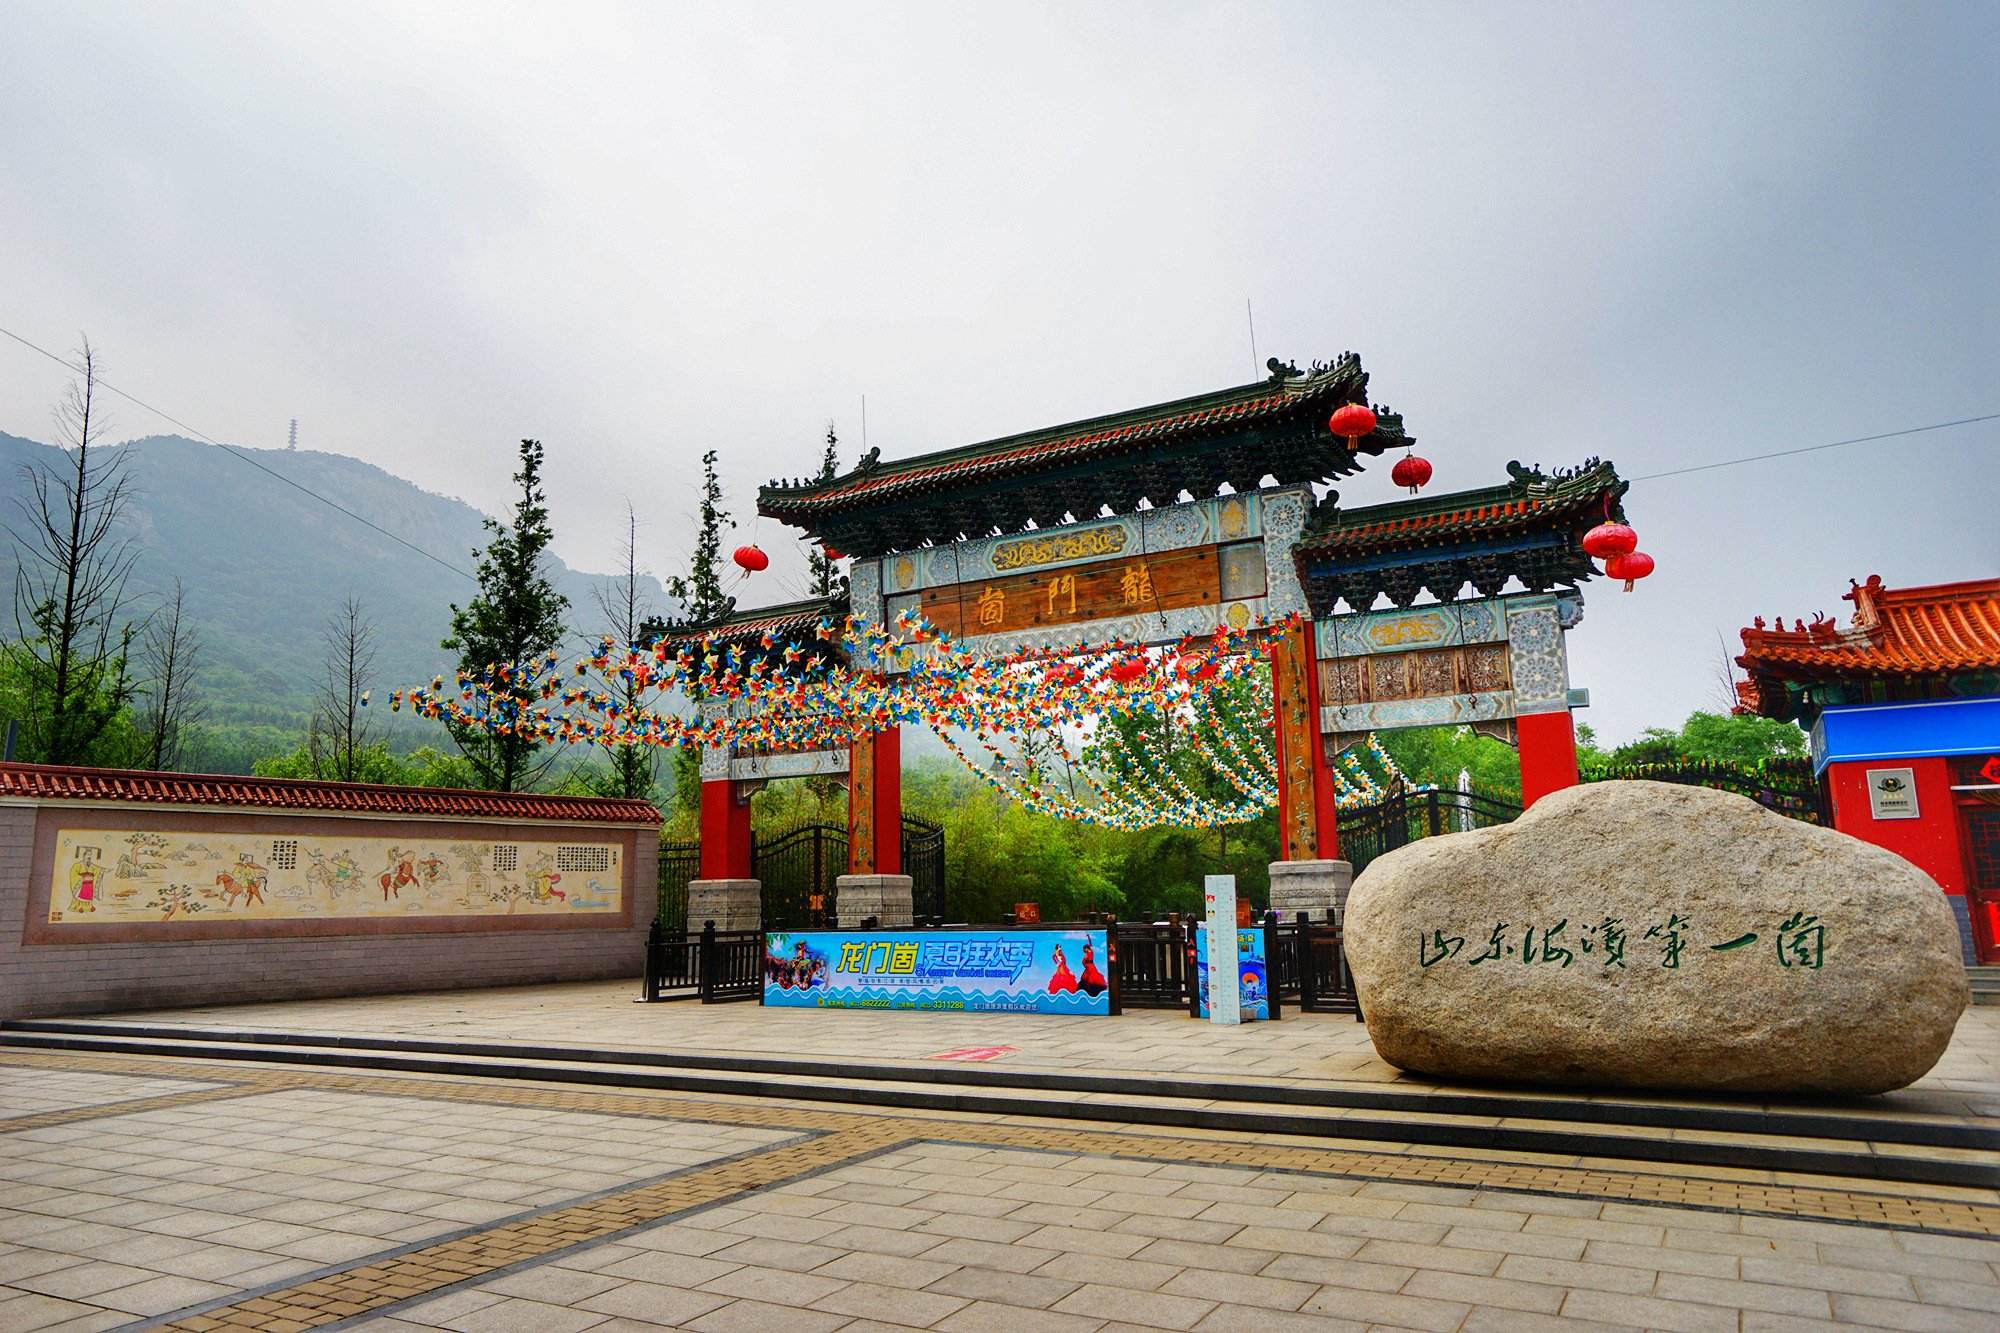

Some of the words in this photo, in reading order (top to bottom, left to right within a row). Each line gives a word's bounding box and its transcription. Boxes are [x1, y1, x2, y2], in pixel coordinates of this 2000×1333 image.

[836, 941, 921, 974] 龙门崮
[922, 938, 1035, 985] 夏日狂欢季
